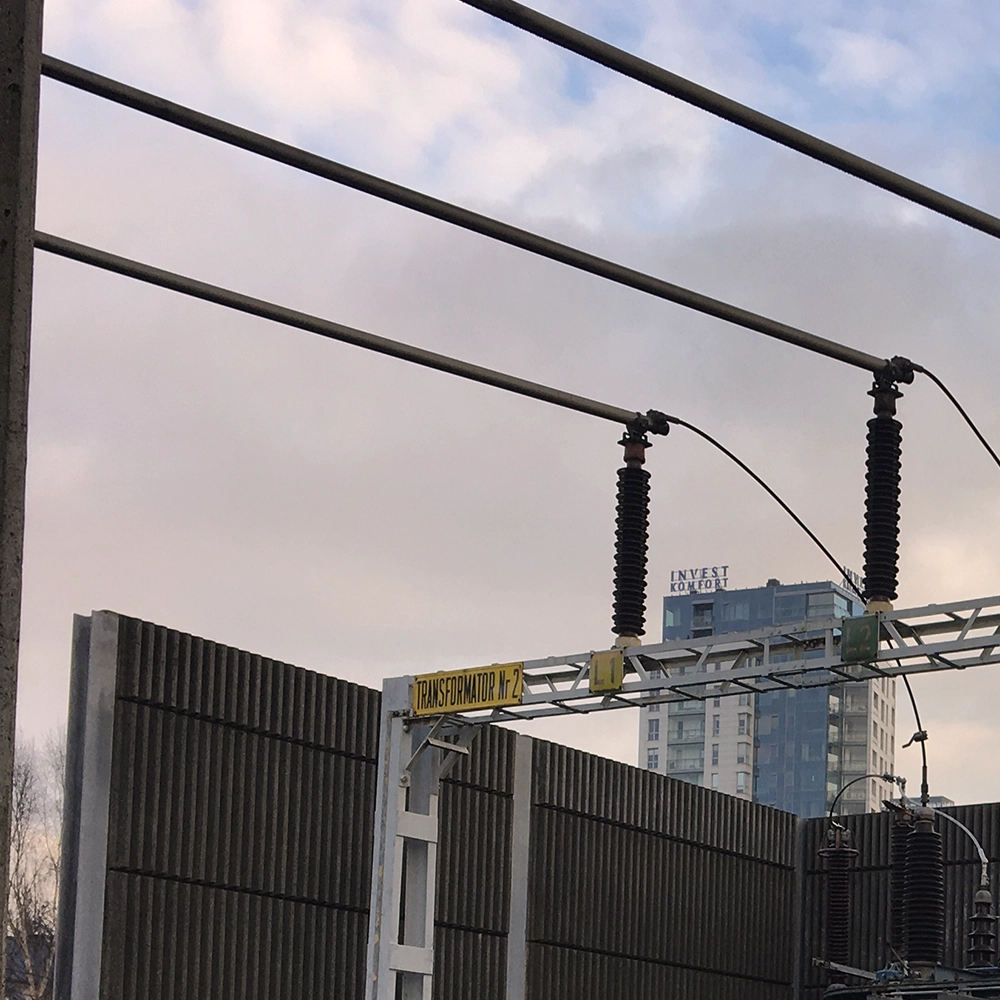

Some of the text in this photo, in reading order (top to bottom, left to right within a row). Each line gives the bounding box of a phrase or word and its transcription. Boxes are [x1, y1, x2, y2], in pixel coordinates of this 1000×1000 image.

[671, 566, 729, 582] INVEST
[670, 578, 728, 592] KOMFORT
[594, 658, 615, 685] L1
[417, 668, 520, 710] TRANSFORMATOR Nr 2
